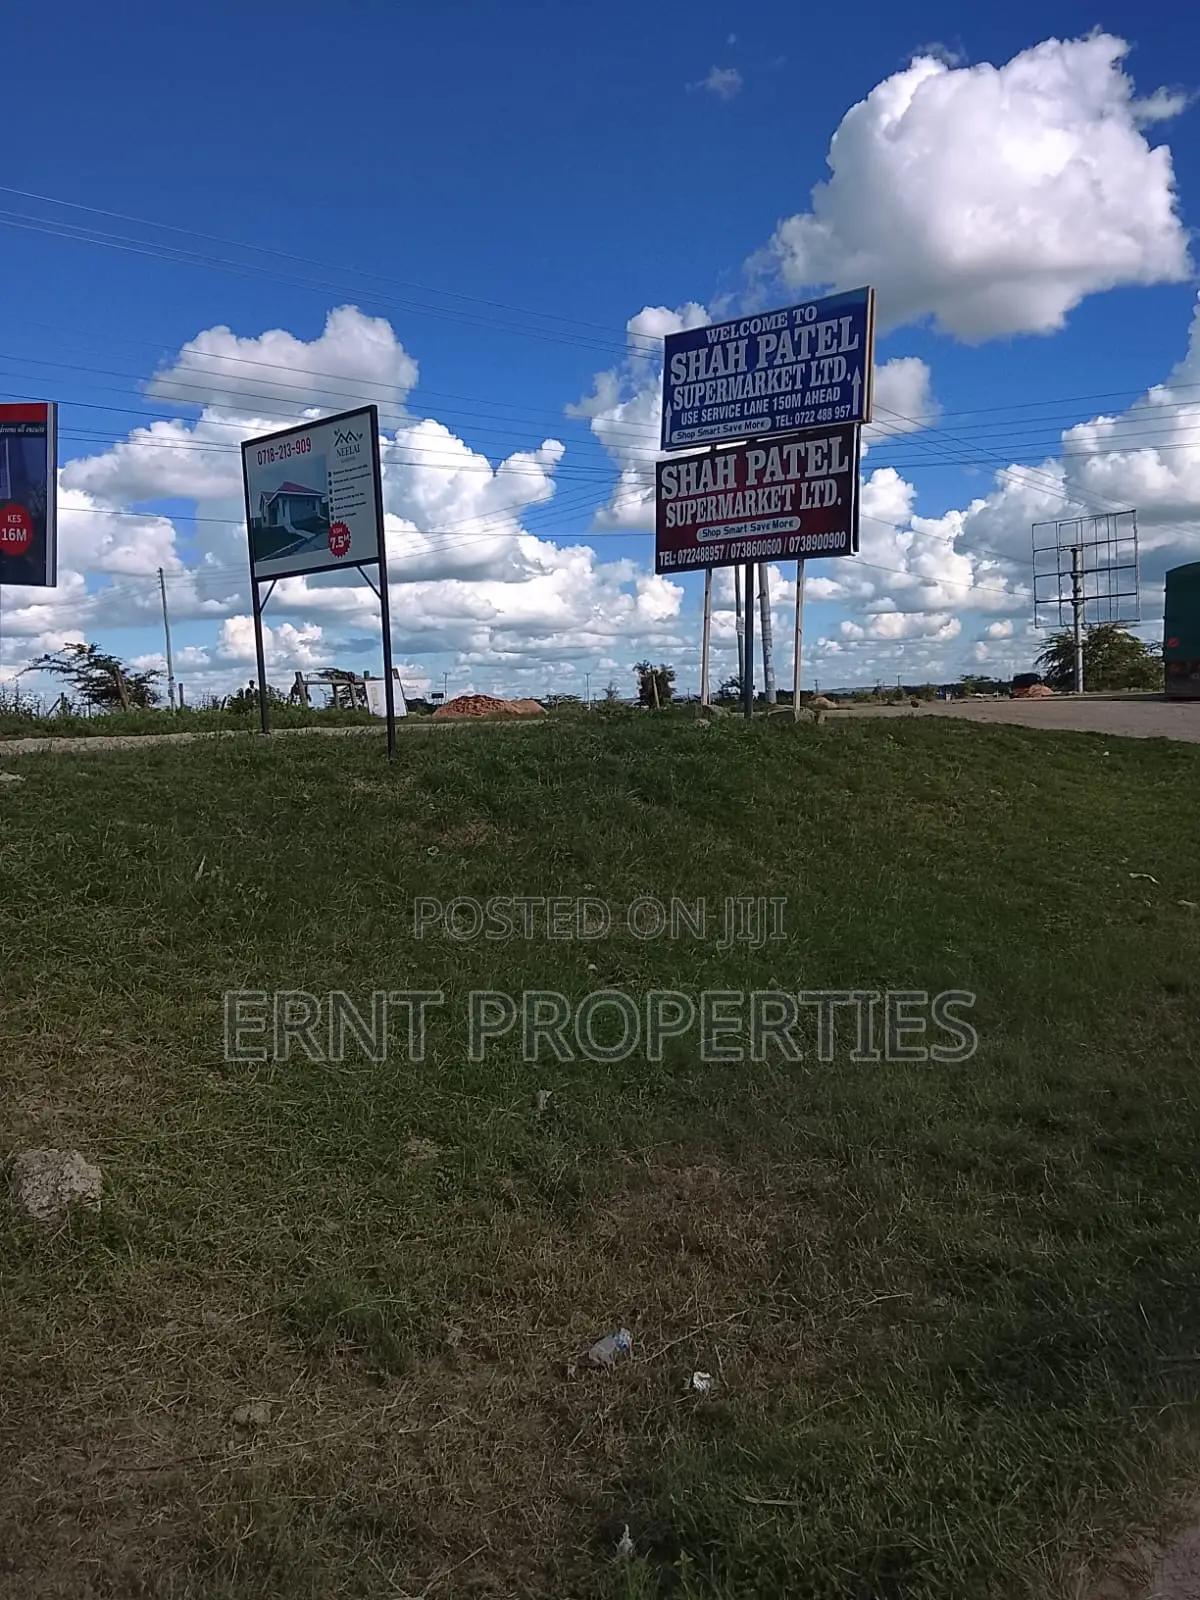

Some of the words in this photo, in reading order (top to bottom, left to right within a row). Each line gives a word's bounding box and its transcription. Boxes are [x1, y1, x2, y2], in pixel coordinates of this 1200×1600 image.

[706, 312, 788, 344] WELCOME
[793, 306, 818, 324] TO
[670, 340, 748, 386] SHAH
[756, 316, 859, 370] PATEL
[673, 366, 806, 410] SUPERMARKET
[810, 355, 851, 386] LTD.
[681, 409, 698, 426] USE
[702, 405, 740, 422] SERVICE
[744, 399, 769, 416] LANE
[772, 396, 802, 412] 150M
[804, 387, 840, 406] AHEAD
[775, 414, 793, 428] TEL:
[795, 410, 815, 425] 0722
[834, 405, 851, 419] 957
[677, 431, 696, 441] Shop
[697, 426, 721, 437] Smart
[723, 423, 743, 433] Save
[744, 420, 765, 430] More
[661, 453, 737, 500] SHAH
[746, 436, 848, 486] PATEL
[8, 514, 22, 523] KES
[666, 484, 796, 528] SUPERMARKET
[800, 478, 842, 510] LTD.
[2, 528, 27, 542] 16M
[702, 528, 721, 538] Shop
[724, 524, 748, 536] Smart
[750, 521, 770, 532] Save
[772, 518, 794, 528] More
[659, 551, 677, 566] TEL:
[678, 544, 724, 564] 0722488957
[730, 540, 782, 559] 0738600600
[788, 531, 846, 552] 0738900900
